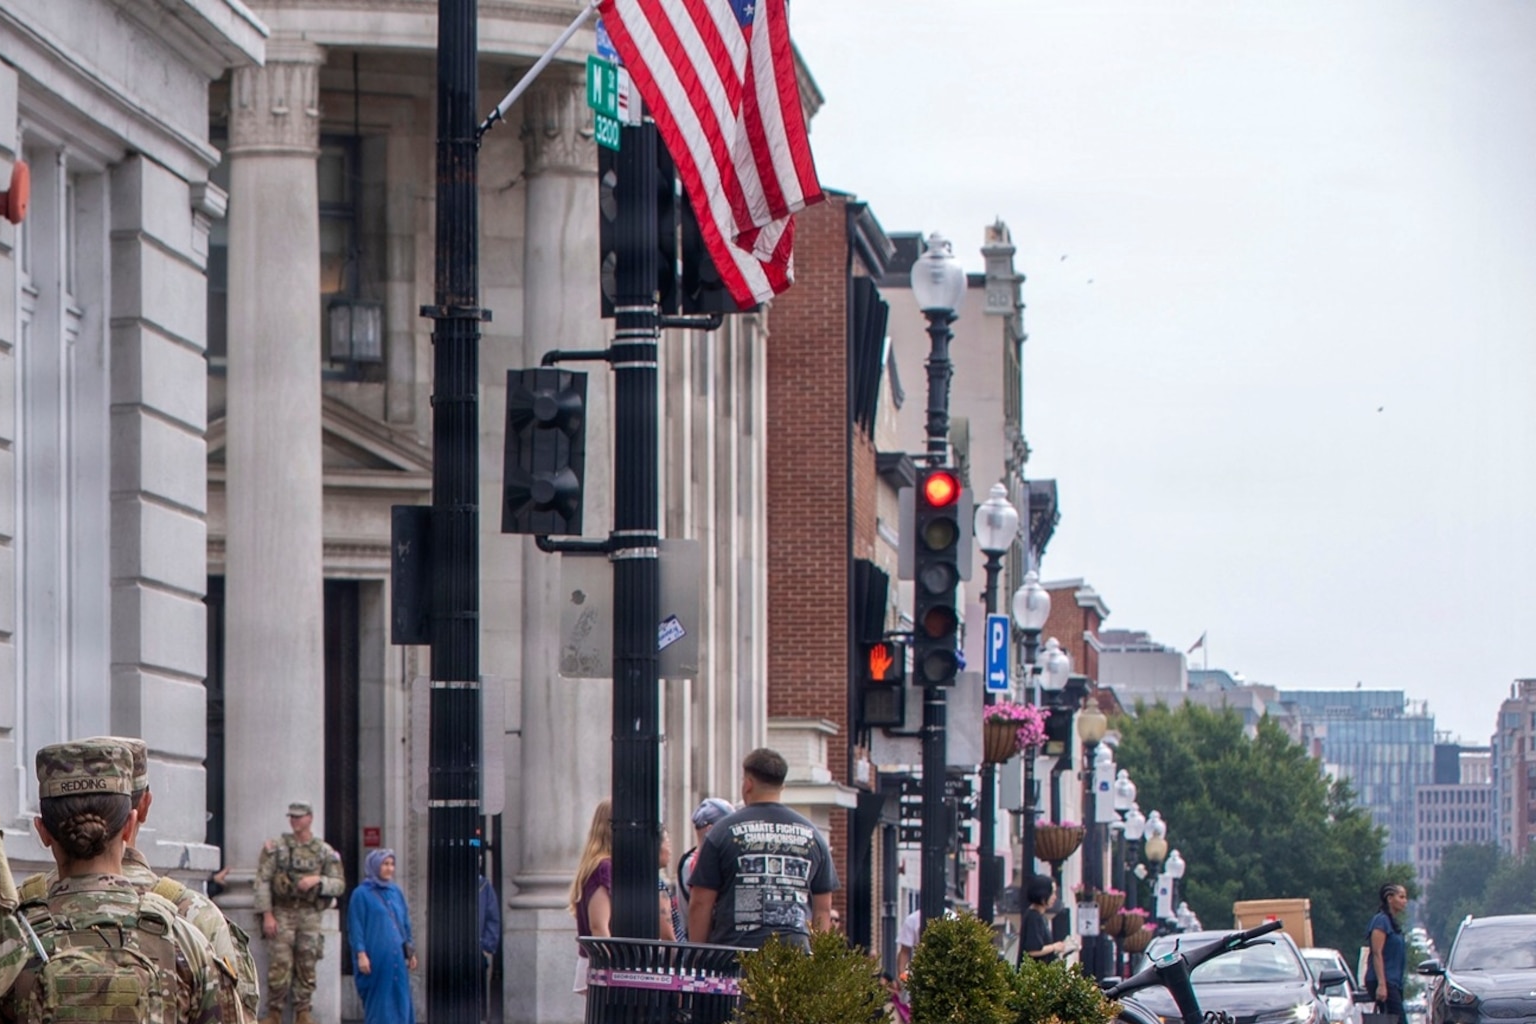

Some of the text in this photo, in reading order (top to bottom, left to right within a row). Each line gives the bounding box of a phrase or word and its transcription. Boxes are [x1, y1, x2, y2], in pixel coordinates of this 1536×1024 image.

[593, 64, 602, 105] M
[596, 114, 619, 146] 3200
[993, 622, 1004, 664] P
[60, 778, 107, 793] REDDING
[731, 823, 775, 837] ULTIMATE
[775, 823, 814, 840] FIGHTING
[744, 833, 808, 846] CHAMPIONSHIP
[613, 973, 655, 982] GEORGETOWN
